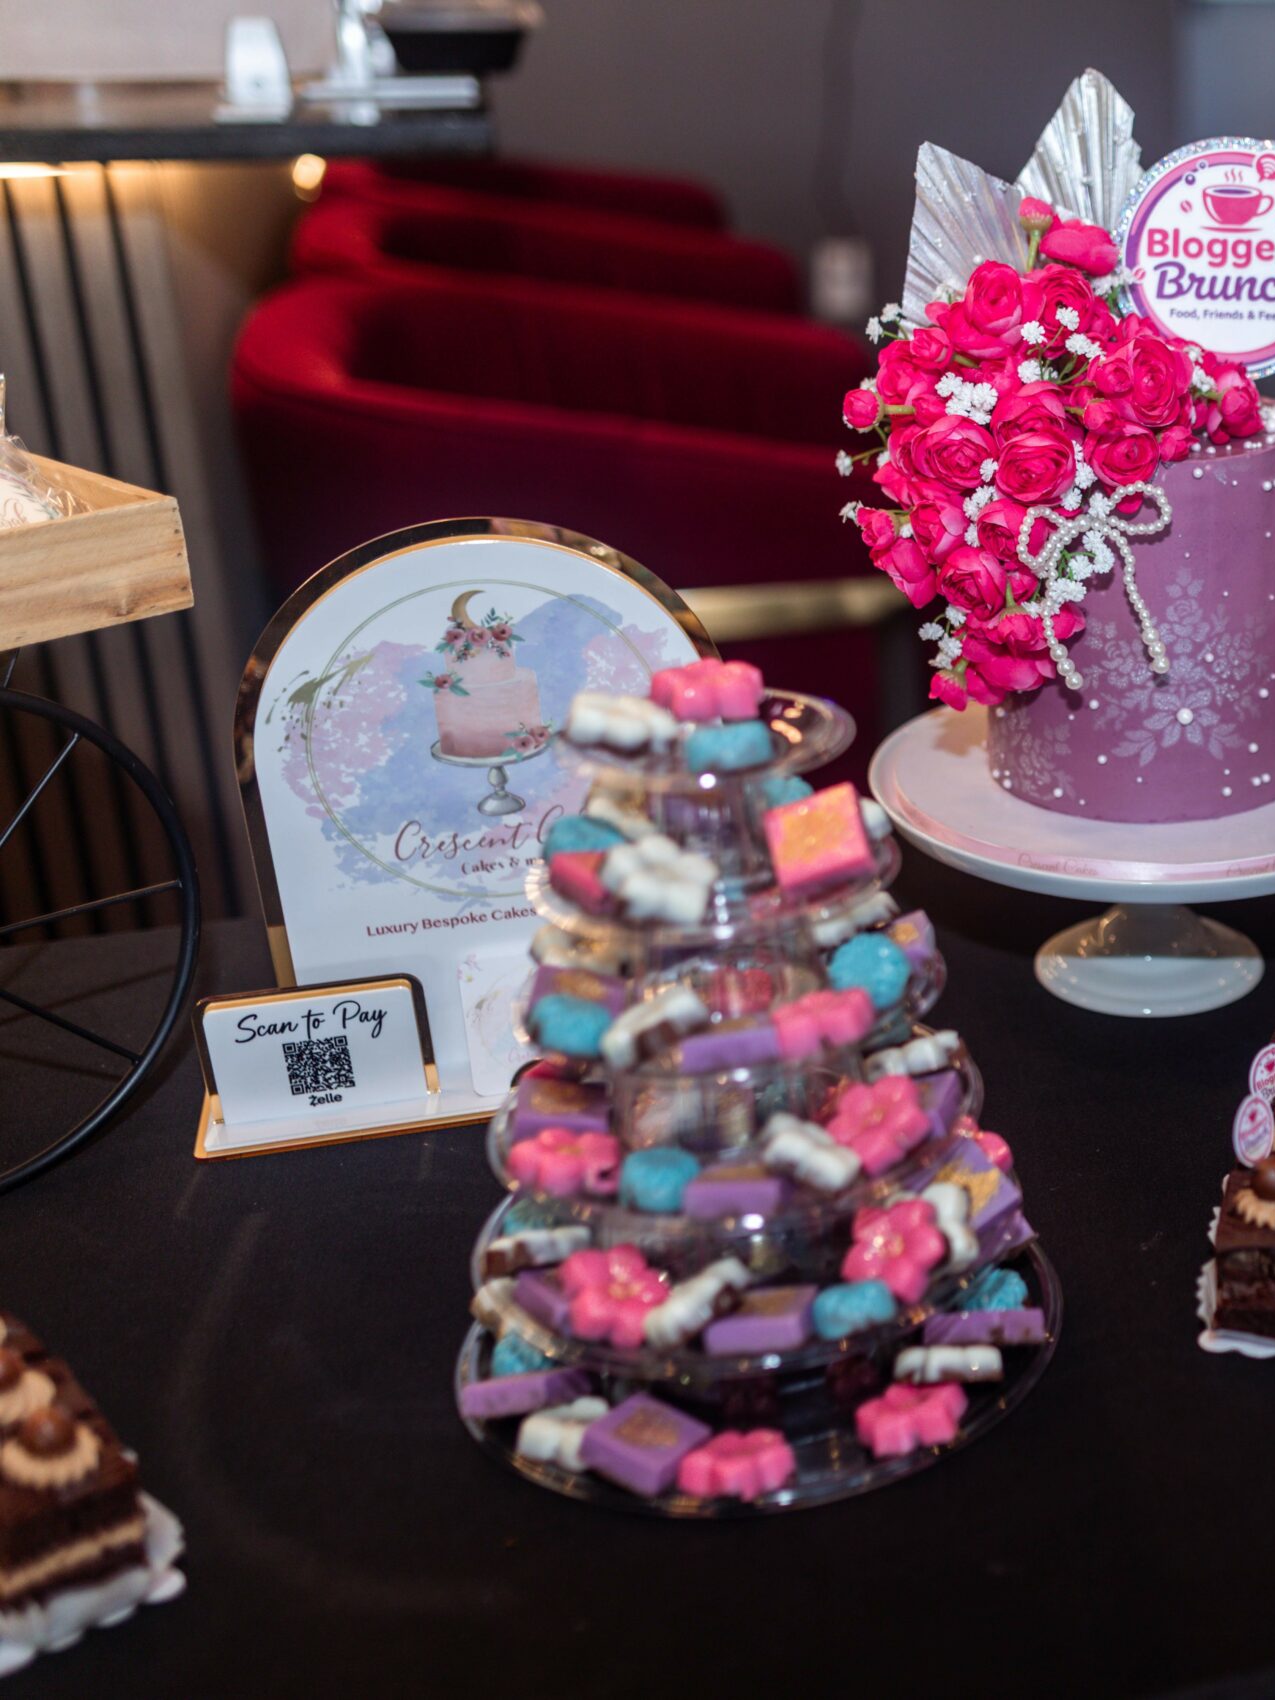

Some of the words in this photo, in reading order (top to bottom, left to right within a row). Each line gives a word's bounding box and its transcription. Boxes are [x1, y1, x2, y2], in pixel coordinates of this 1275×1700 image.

[1170, 308, 1200, 320] Food,
[1203, 308, 1243, 320] Friends
[1247, 310, 1255, 320] &
[394, 820, 534, 862] Crescent
[461, 858, 503, 876] Cakes
[508, 857, 520, 868] &
[366, 921, 419, 937] Luxury
[422, 911, 488, 931] Bespoke
[491, 906, 537, 922] Cakes
[234, 1013, 298, 1044] Scan
[302, 1009, 326, 1040] to
[332, 1000, 387, 1039] Pay
[309, 1091, 343, 1107] Zelle
